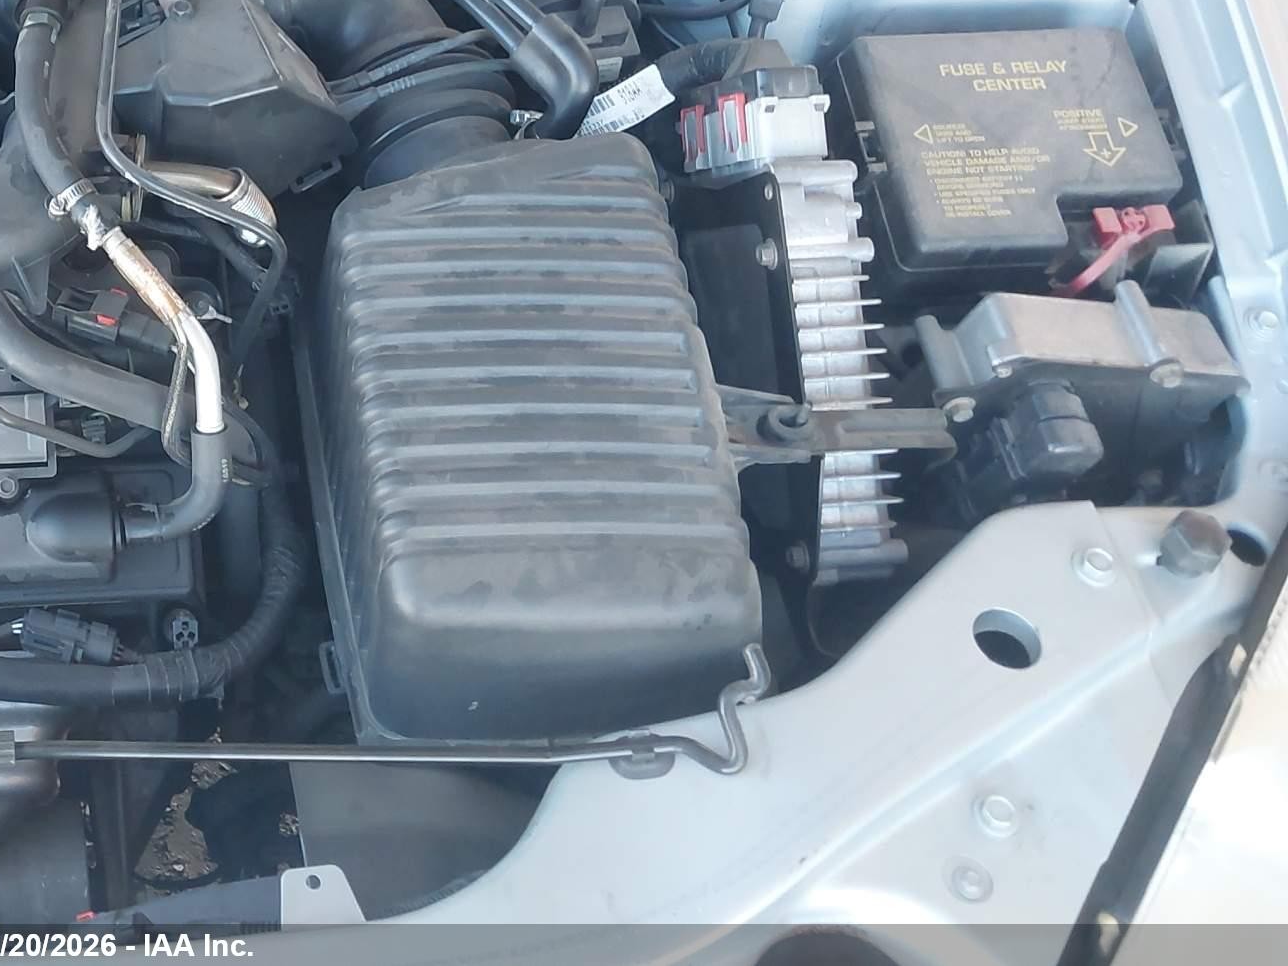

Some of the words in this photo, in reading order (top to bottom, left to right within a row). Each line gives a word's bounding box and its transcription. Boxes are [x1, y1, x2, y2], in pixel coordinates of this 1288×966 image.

[939, 63, 986, 76] FUSE
[992, 62, 1006, 75] &
[1011, 60, 1067, 74] RELAY
[973, 77, 1048, 92] CENTER
[1053, 109, 1103, 119] POSITIVE
[969, 149, 982, 157] TO
